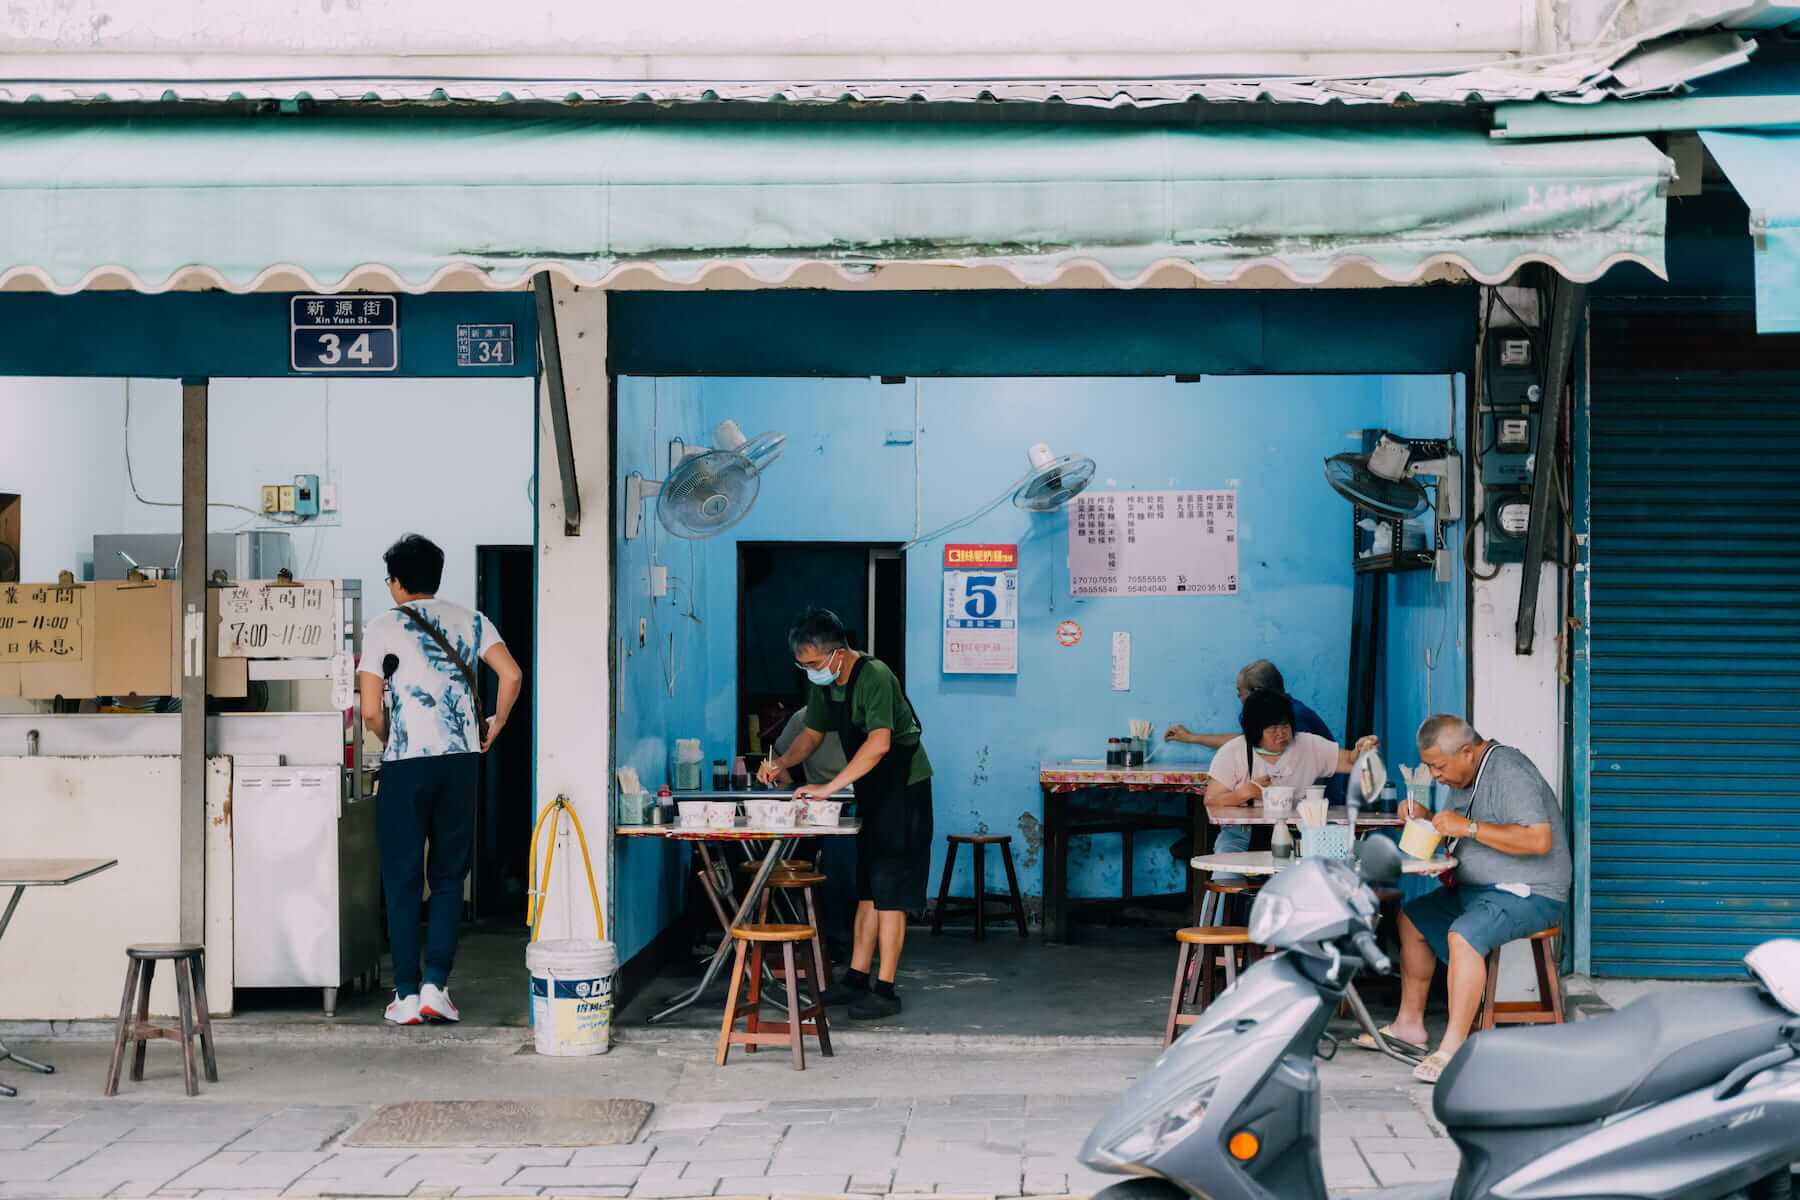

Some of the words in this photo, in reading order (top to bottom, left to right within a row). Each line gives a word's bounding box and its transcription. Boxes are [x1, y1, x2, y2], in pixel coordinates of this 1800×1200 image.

[307, 301, 381, 316] 新源街
[315, 316, 331, 324] Xin
[333, 316, 356, 324] Yuan
[357, 316, 372, 324] St.
[318, 333, 373, 365] 34
[478, 341, 504, 362] 34
[5, 585, 74, 605] 業時間
[228, 583, 322, 613] 營業時間
[965, 576, 997, 618] 5
